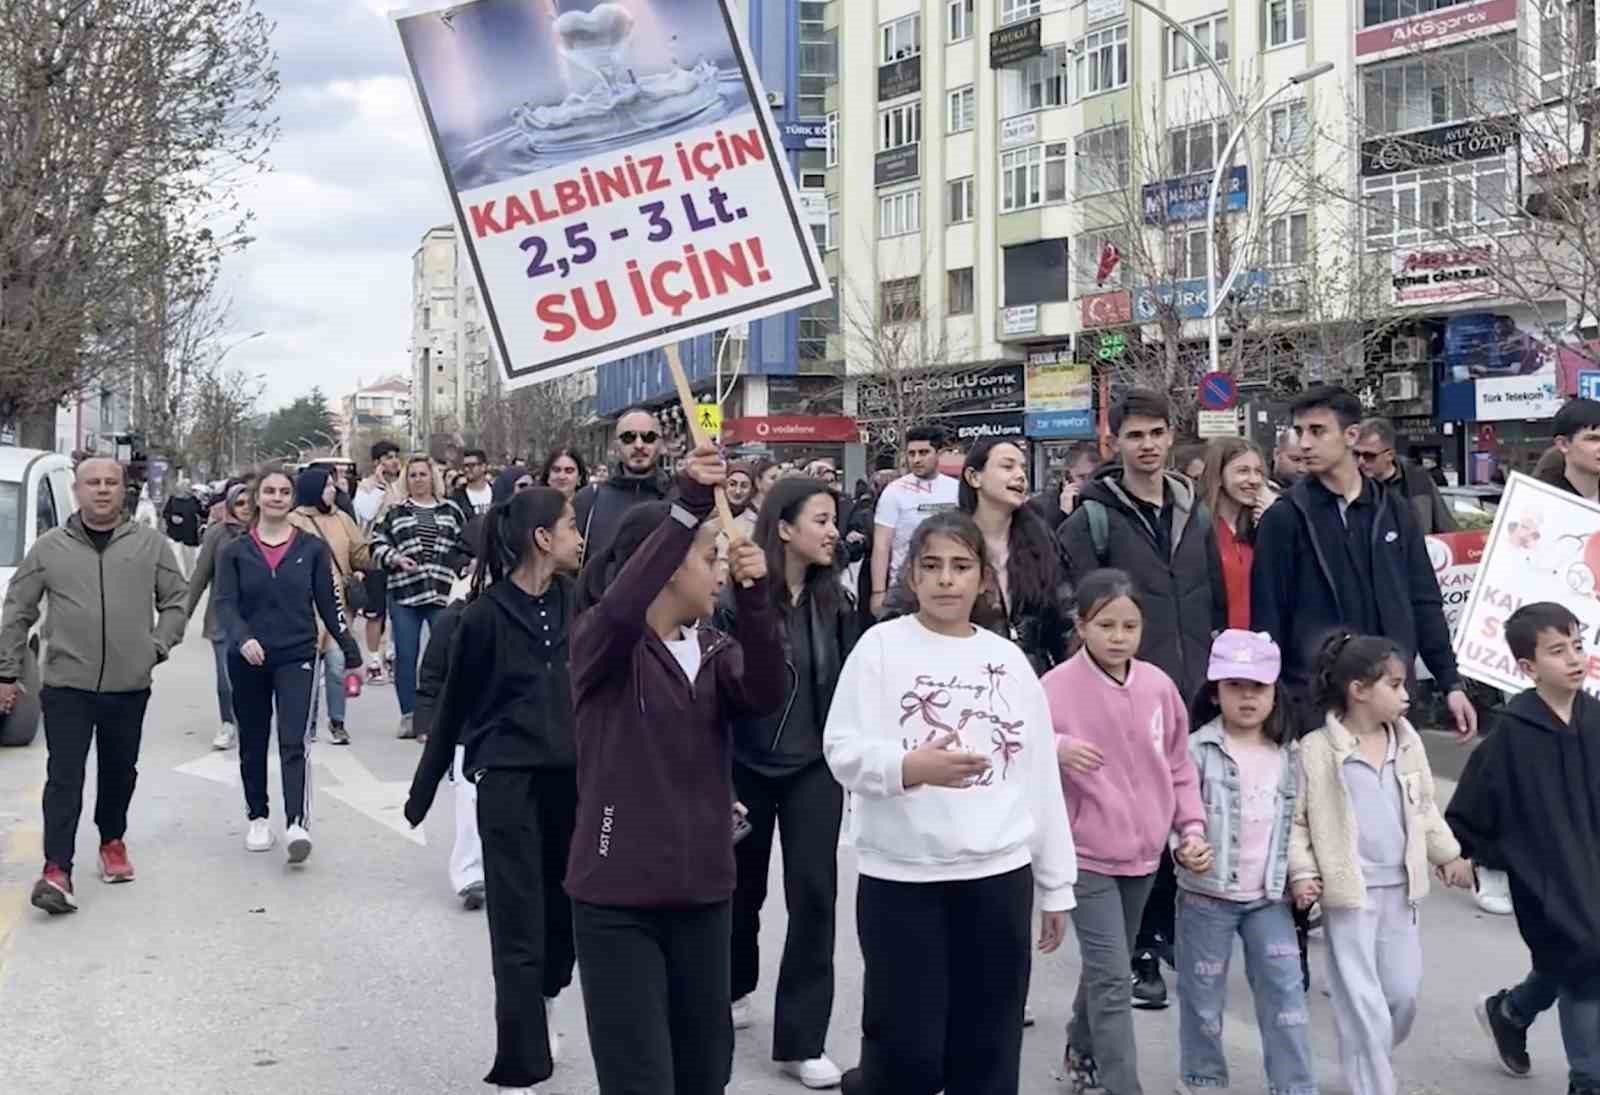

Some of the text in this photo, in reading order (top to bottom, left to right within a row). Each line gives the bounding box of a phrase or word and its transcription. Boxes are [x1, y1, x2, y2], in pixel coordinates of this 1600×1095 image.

[468, 129, 766, 239] KALBİNİZ İÇİN
[519, 186, 748, 280] 2,5 - 3 Lt.
[535, 236, 772, 344] SU İÇİN!
[1505, 391, 1544, 402] Telekom
[772, 423, 815, 434] vodafone
[914, 675, 990, 699] Feeling
[957, 708, 1025, 735] good
[601, 816, 613, 833] DO
[599, 833, 611, 857] JUST
